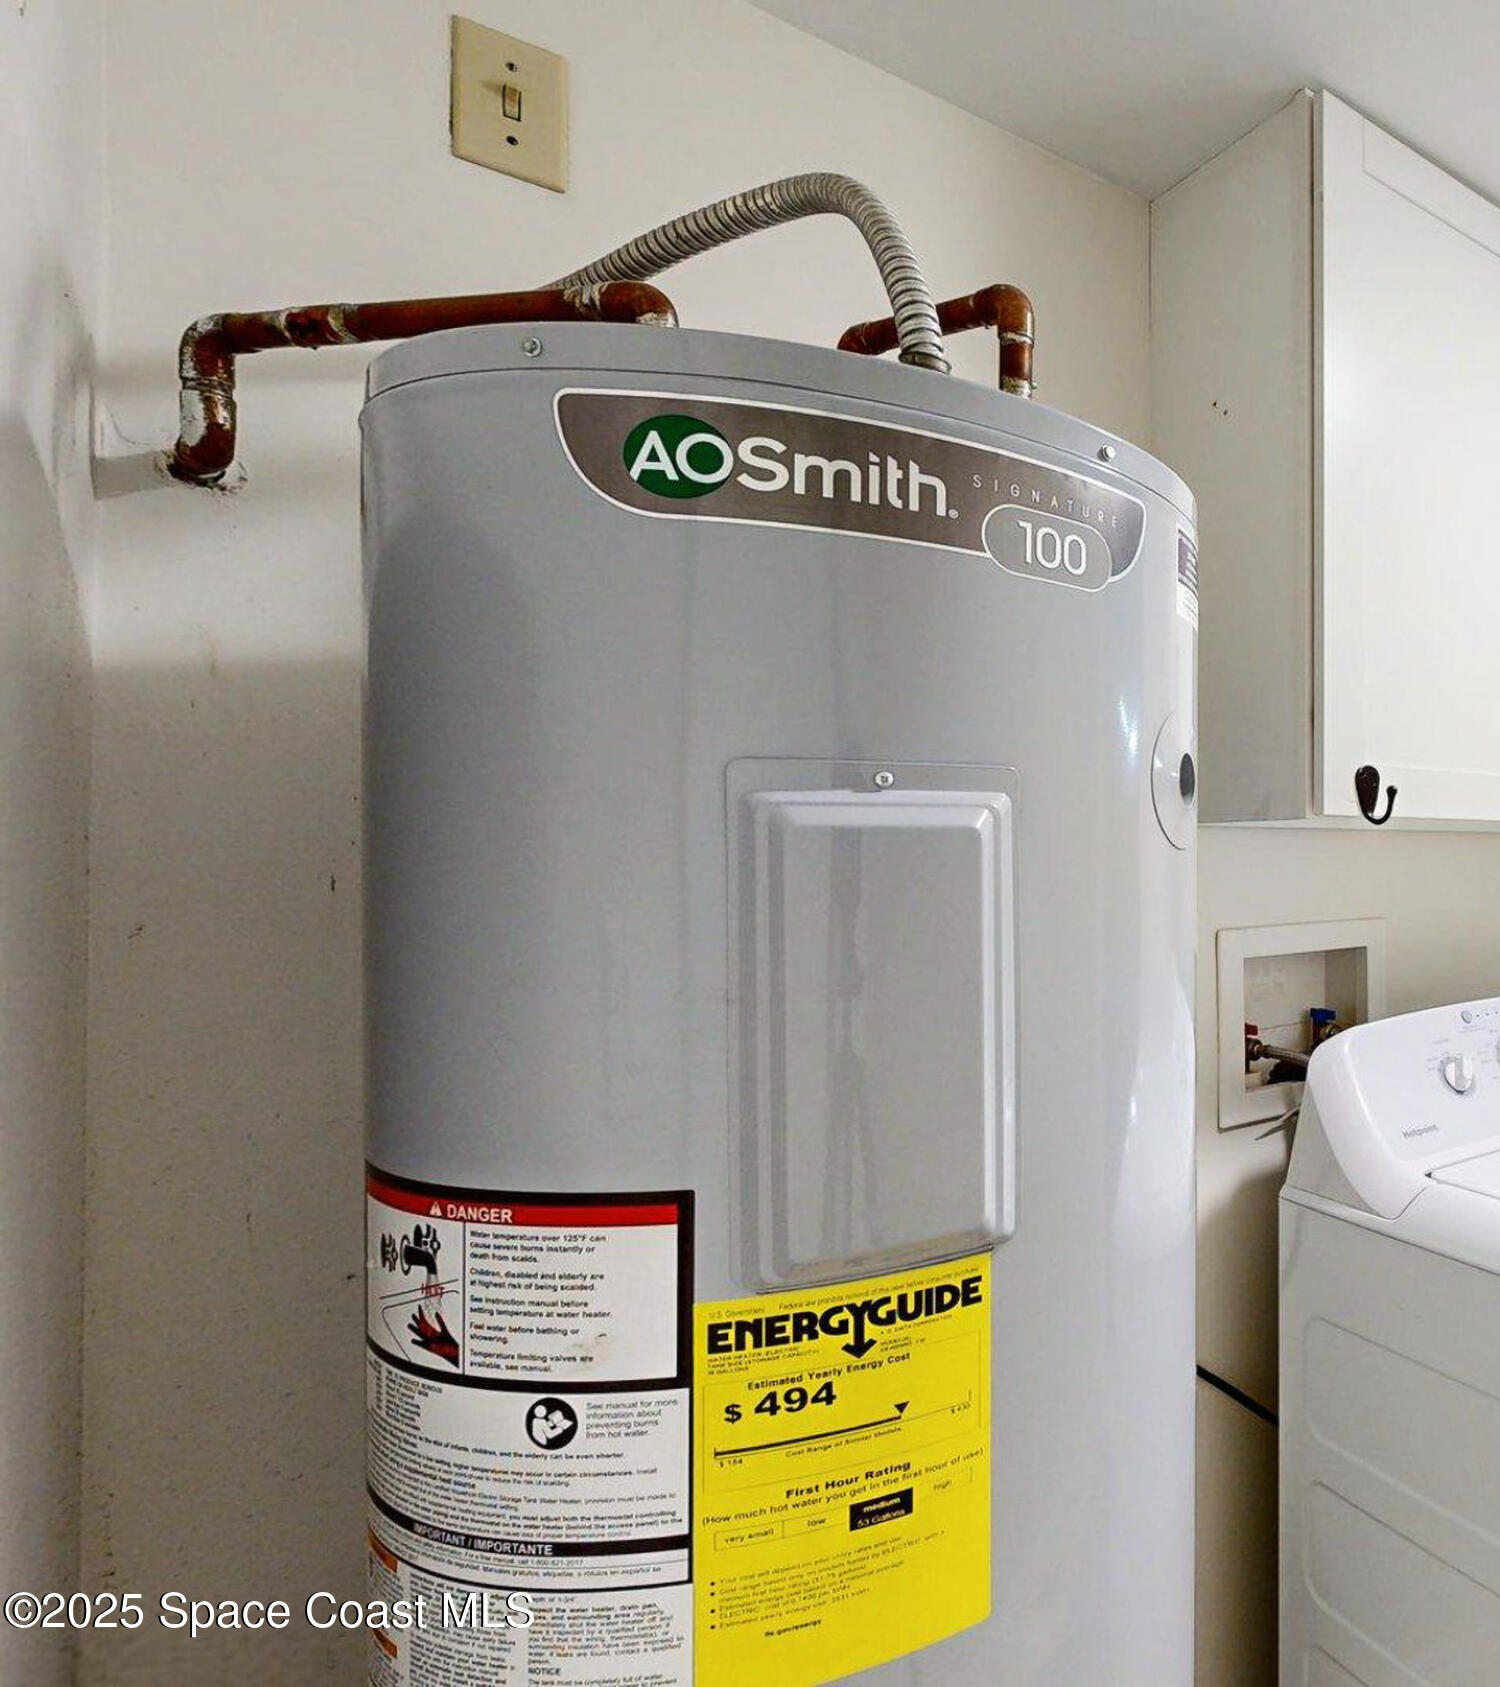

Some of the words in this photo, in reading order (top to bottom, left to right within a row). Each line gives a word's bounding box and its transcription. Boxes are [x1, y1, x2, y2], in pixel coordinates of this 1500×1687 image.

[973, 474, 1119, 529] SIGNATURE
[1017, 519, 1088, 577] 100
[447, 1204, 513, 1224] DANGER
[470, 1230, 490, 1238] Water
[492, 1232, 539, 1242] temperature
[520, 1244, 544, 1252] burns
[546, 1245, 583, 1254] instantly
[504, 1270, 538, 1279] disabled
[558, 1272, 587, 1281] elderly
[478, 1280, 505, 1289] highest
[508, 1282, 522, 1290] risk
[524, 1282, 533, 1290] of
[534, 1283, 558, 1292] being
[470, 1295, 482, 1303] See
[485, 1298, 526, 1306] instruction
[528, 1300, 559, 1308] manual
[560, 1300, 589, 1308] before
[470, 1307, 494, 1316] setting
[496, 1308, 543, 1317] temperature
[707, 1276, 982, 1354] ENERGYGUIDE
[470, 1322, 484, 1330] Feel
[486, 1324, 506, 1332] water
[508, 1325, 534, 1334] before
[536, 1327, 568, 1336] bathing
[470, 1349, 515, 1360] Temperature
[517, 1353, 547, 1363] limiting
[550, 1354, 577, 1362] valves
[748, 1374, 803, 1391] Estimated
[808, 1366, 842, 1382] Yearly
[846, 1359, 884, 1374] Energy
[887, 1352, 910, 1363] Cost
[606, 1401, 638, 1409] manual
[724, 1403, 742, 1424] $
[754, 1381, 836, 1417] 494
[586, 1422, 632, 1430] preventing
[633, 1419, 659, 1427] burns
[702, 1515, 732, 1526] (How
[734, 1509, 766, 1520] much
[769, 1503, 789, 1515] hot
[792, 1497, 823, 1509] water
[826, 1491, 847, 1503] you
[849, 1486, 866, 1498] get
[882, 1478, 900, 1489] the
[902, 1471, 923, 1483] first
[924, 1462, 948, 1478] hour
[951, 1455, 961, 1466] of
[963, 1448, 984, 1462] use)
[786, 1484, 820, 1499] First
[825, 1475, 859, 1490] Hour
[865, 1461, 911, 1479] Rating
[863, 1497, 901, 1512] medium
[807, 1517, 826, 1527] low
[411, 1523, 465, 1546] IMPORTANT
[473, 1536, 553, 1556] IMPORTANTE
[725, 1533, 744, 1545] very
[747, 1528, 774, 1540] small
[528, 1667, 562, 1676] NOTICE
